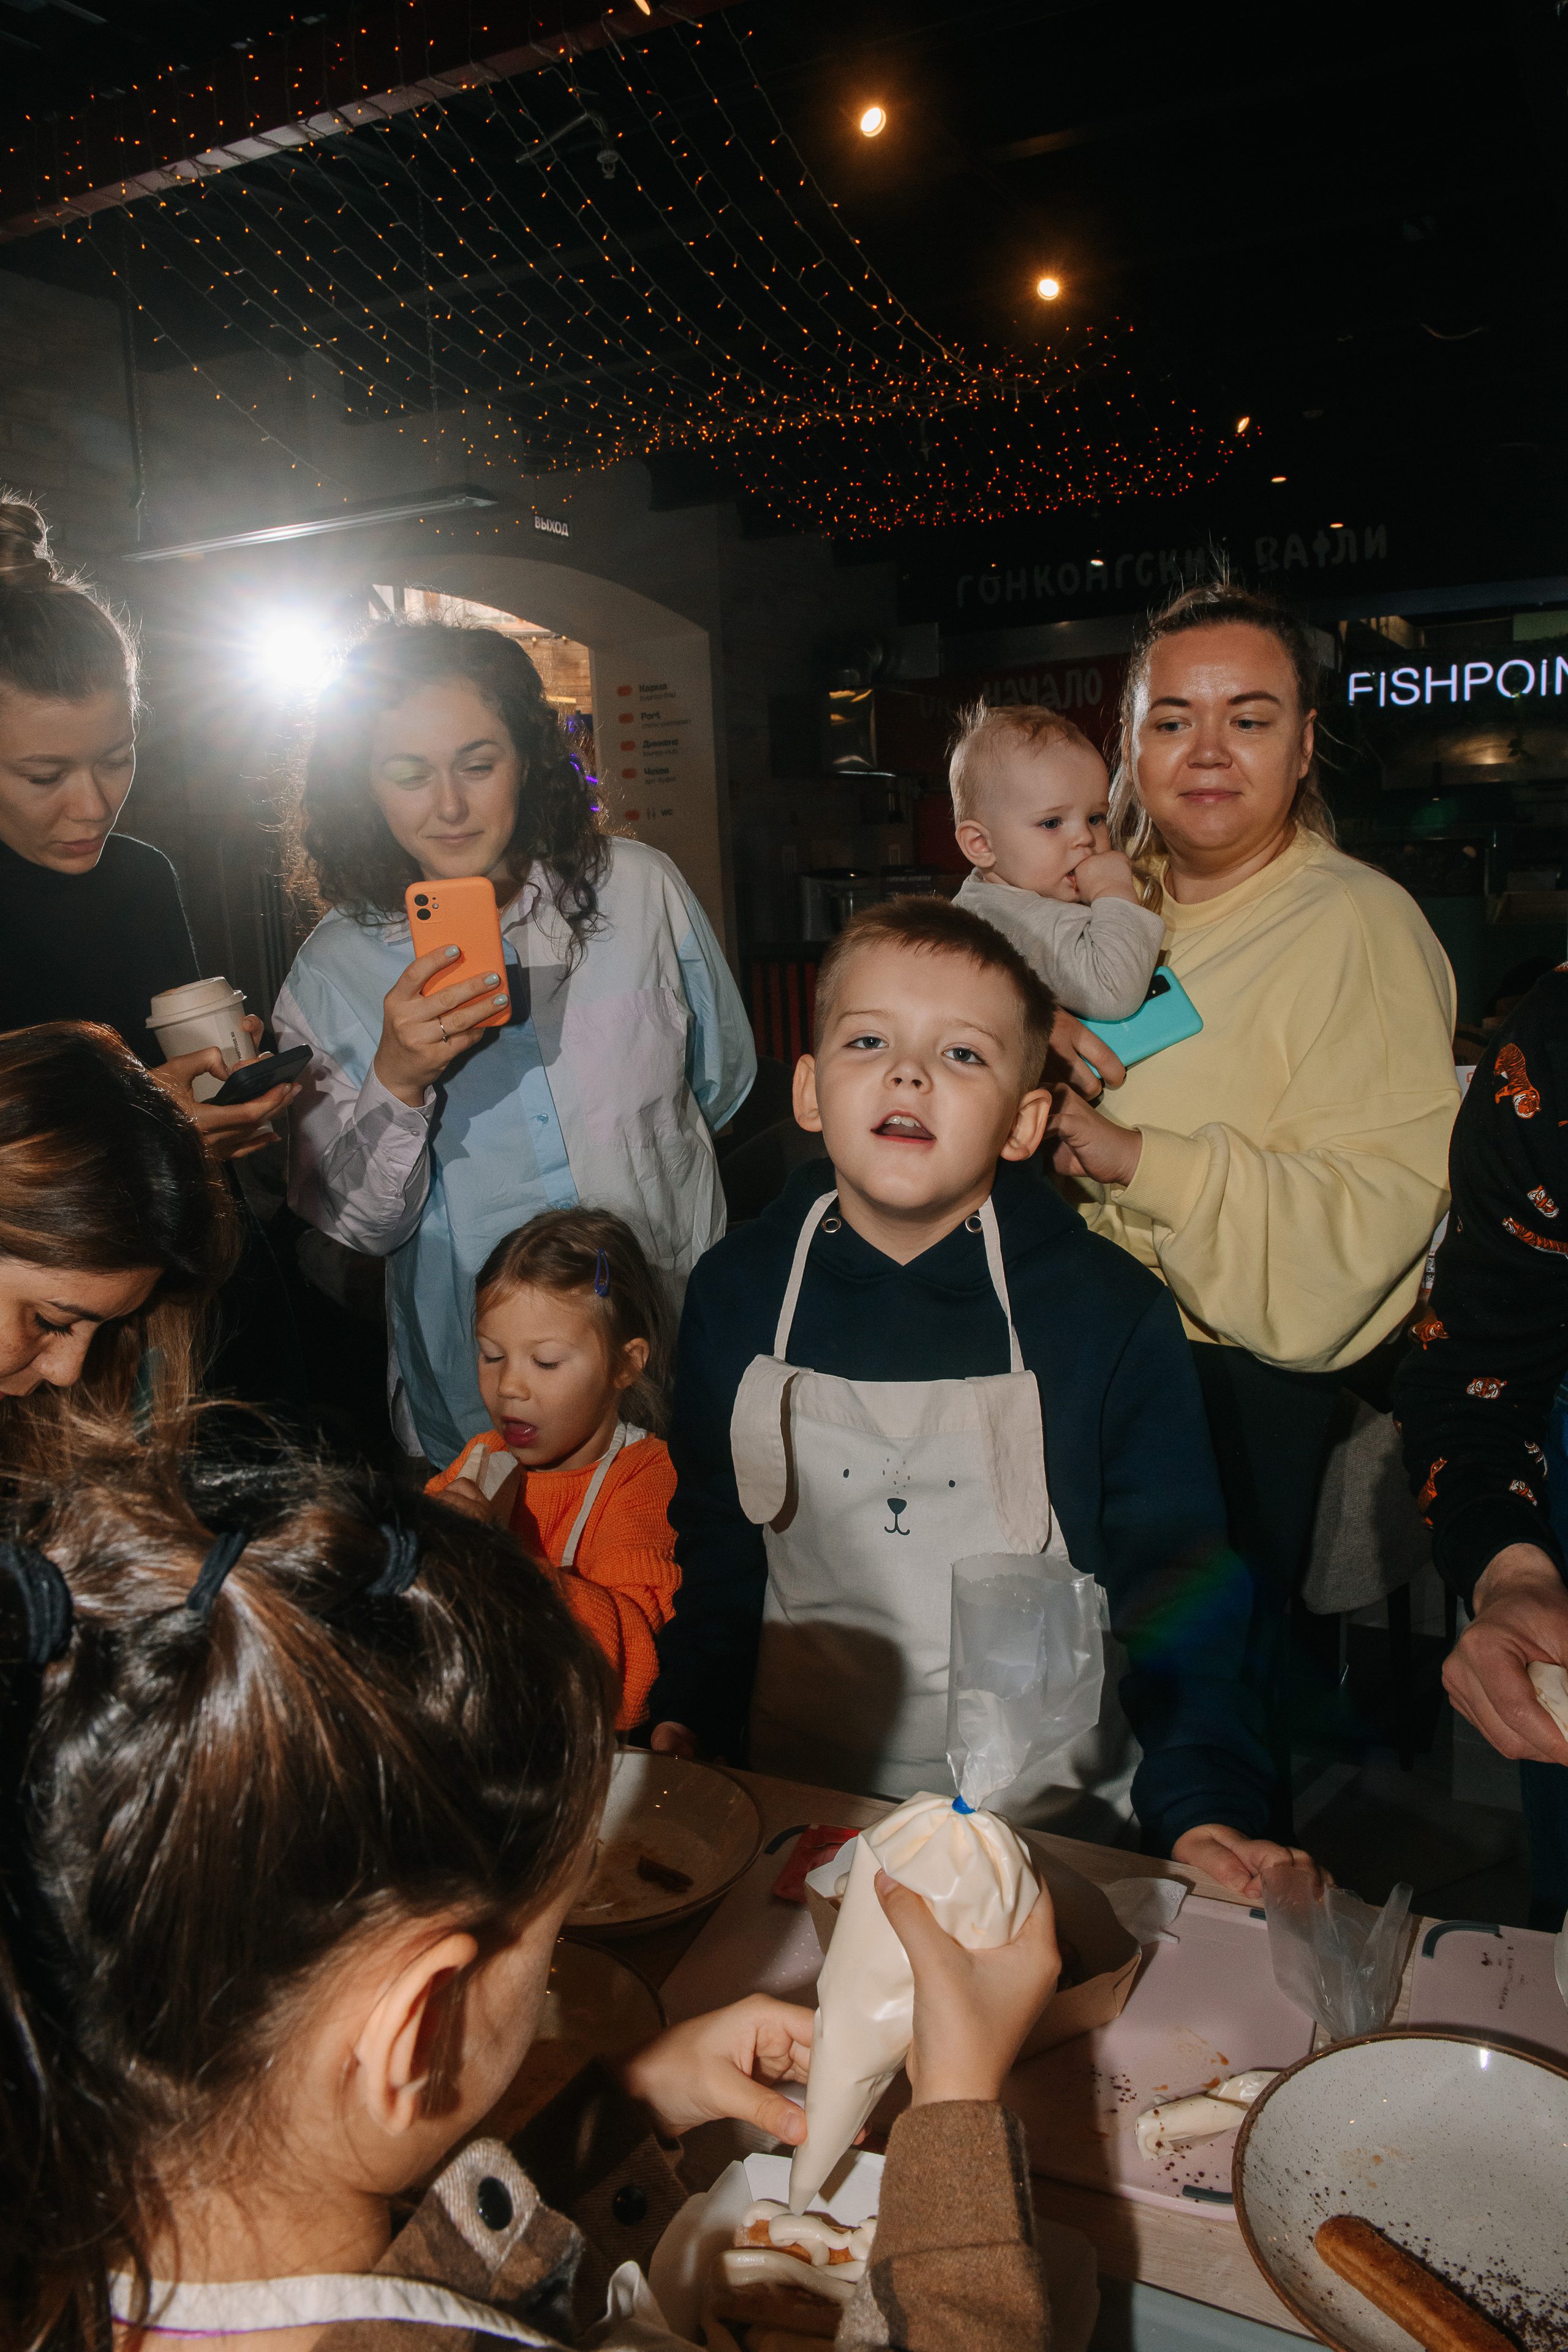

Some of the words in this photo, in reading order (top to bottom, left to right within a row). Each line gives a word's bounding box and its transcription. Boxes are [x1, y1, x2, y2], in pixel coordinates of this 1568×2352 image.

[535, 516, 568, 537] ВЫХОД
[956, 544, 1239, 609] ГОНКОНГСКИ
[641, 711, 660, 720] Port
